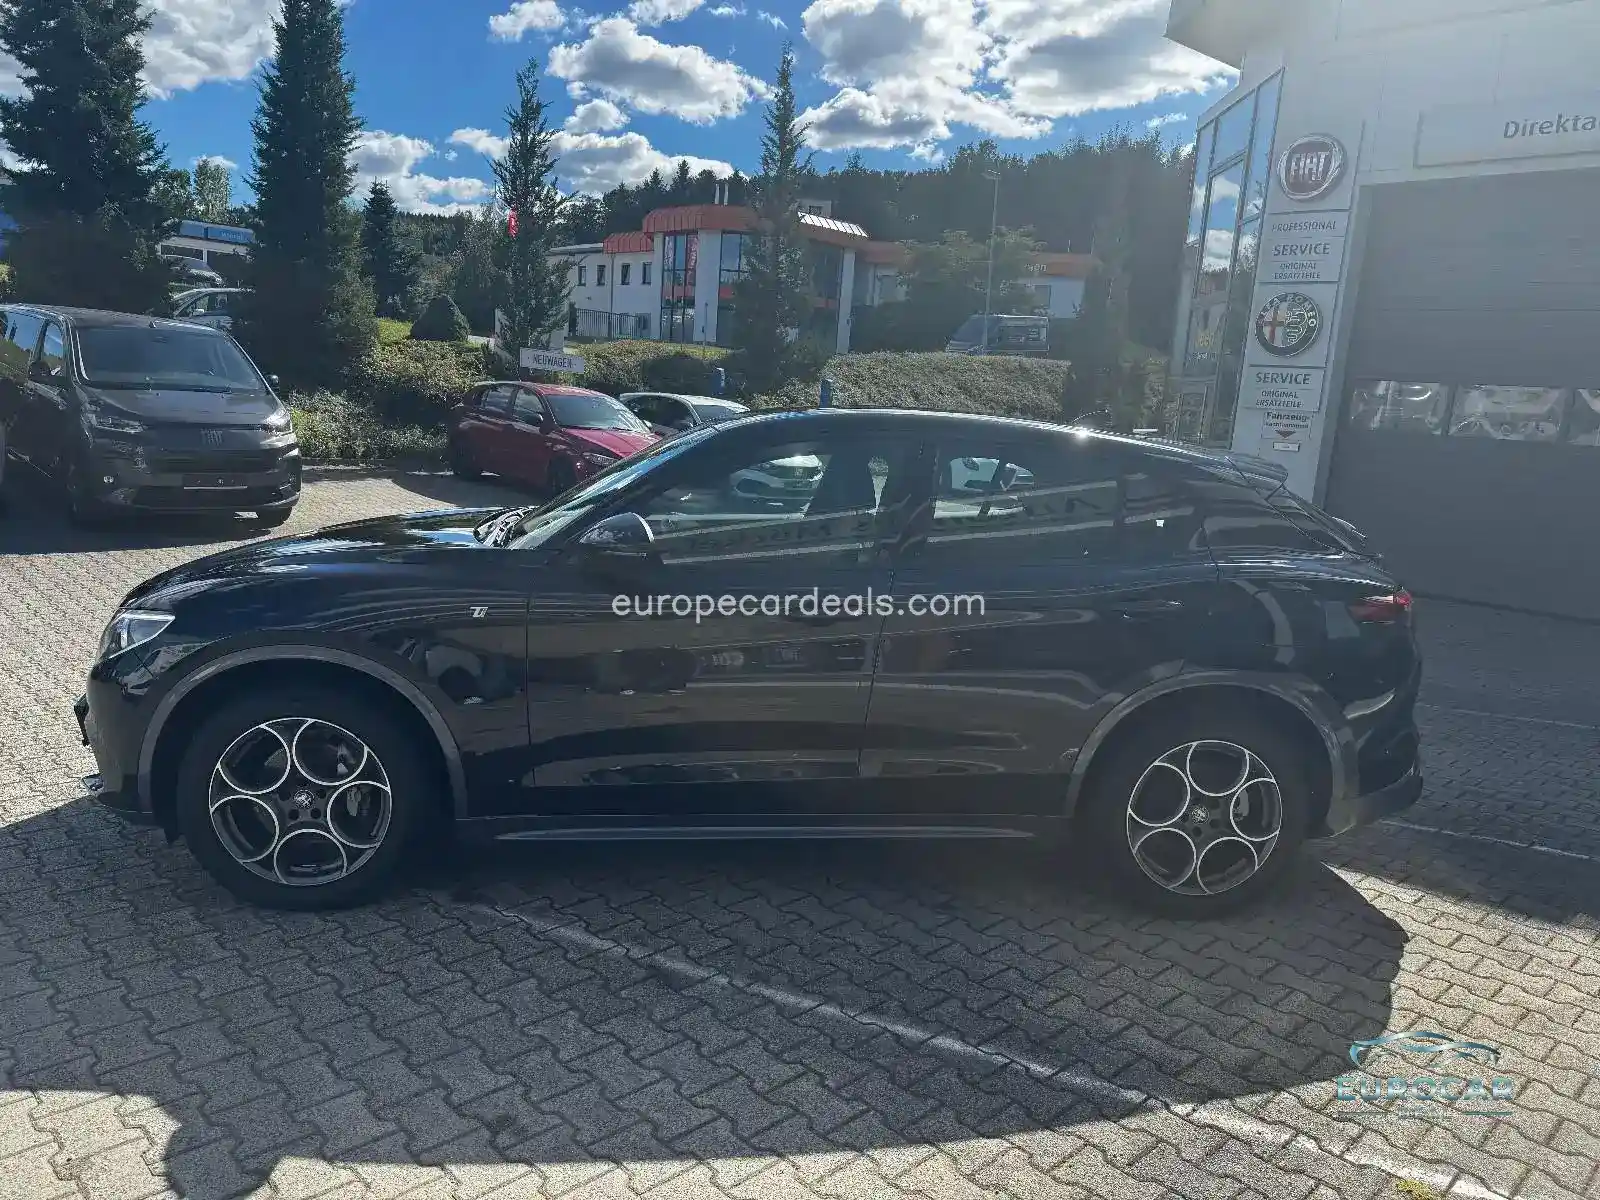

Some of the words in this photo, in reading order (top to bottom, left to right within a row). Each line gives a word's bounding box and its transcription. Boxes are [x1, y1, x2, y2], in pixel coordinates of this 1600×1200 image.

[1503, 111, 1600, 139] Direkta
[1288, 151, 1331, 183] FIAT
[1271, 220, 1337, 232] PROFESSIONAL
[1271, 242, 1331, 257] SERVICE
[1279, 262, 1317, 271] ORIGINAL
[532, 352, 573, 369] NEUWAGEN
[1255, 371, 1313, 385] SERVICE
[1261, 389, 1300, 399] ORIGINAL
